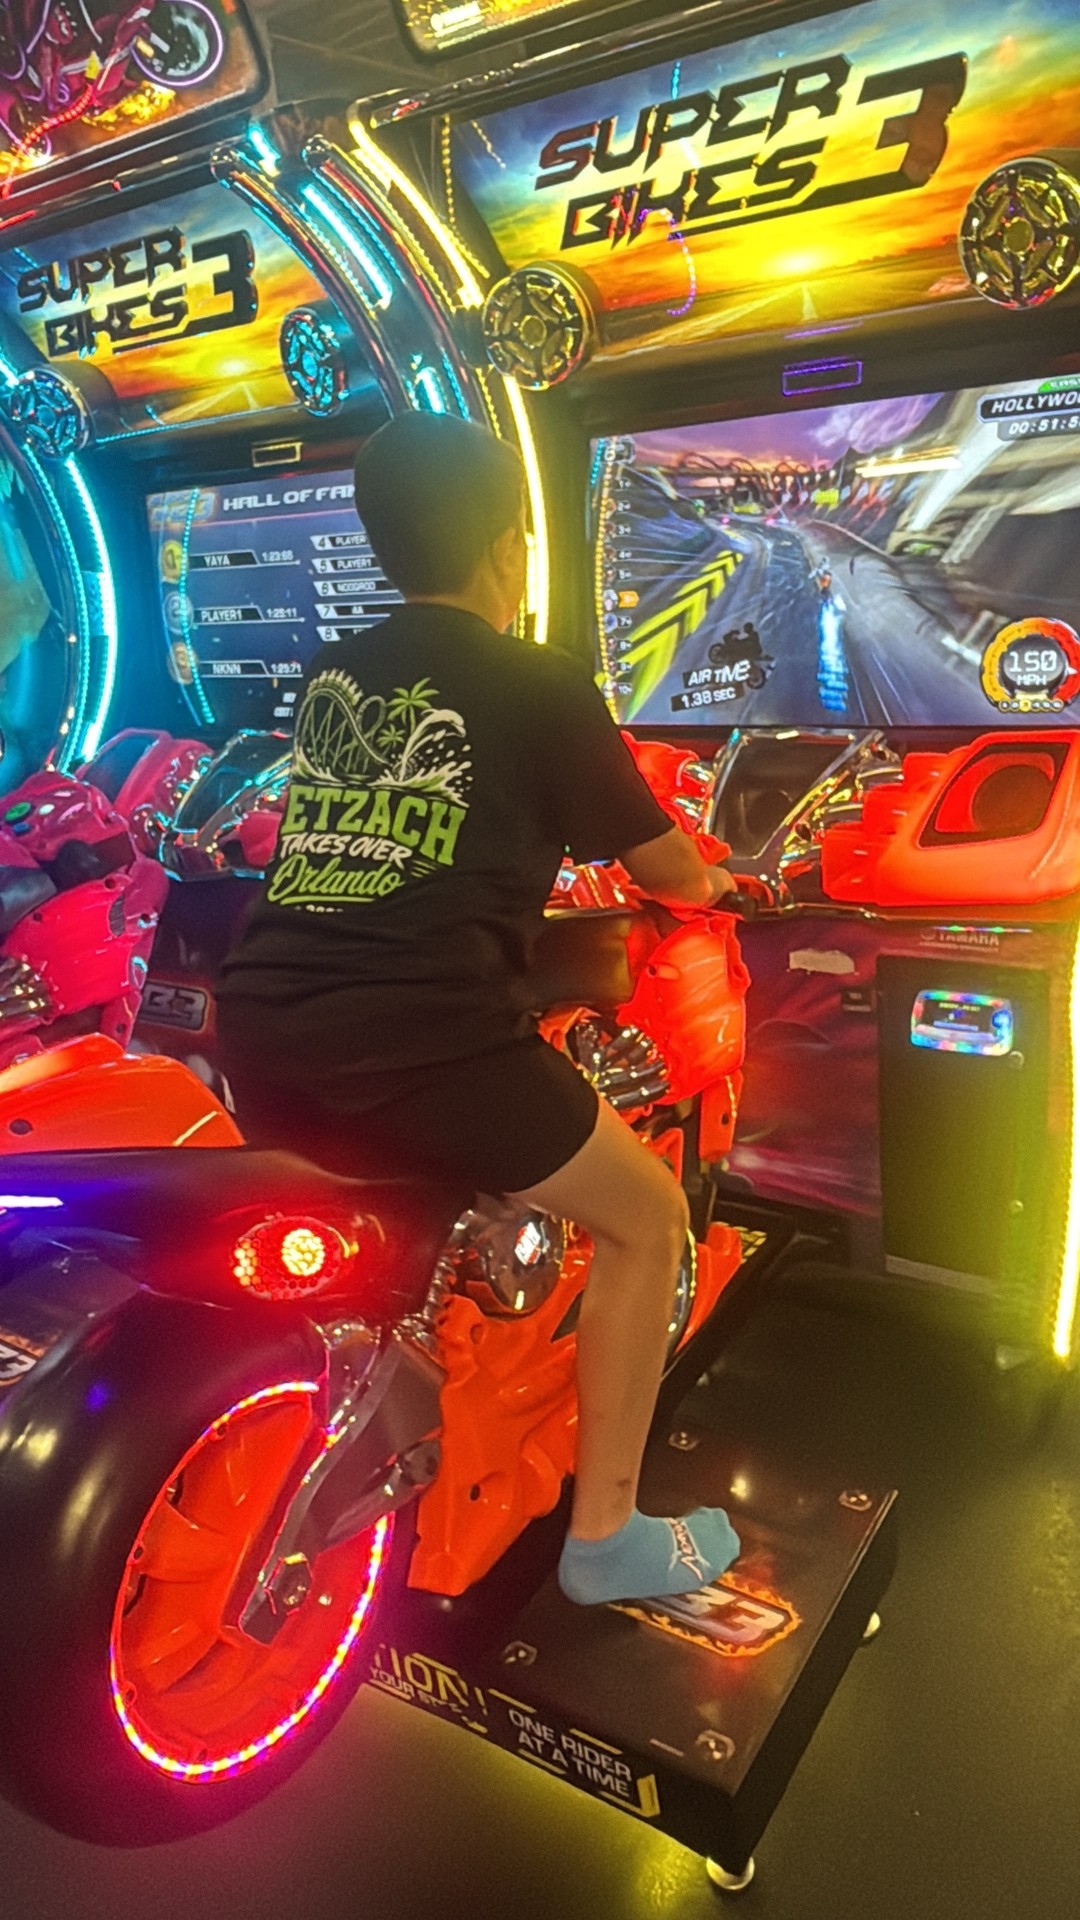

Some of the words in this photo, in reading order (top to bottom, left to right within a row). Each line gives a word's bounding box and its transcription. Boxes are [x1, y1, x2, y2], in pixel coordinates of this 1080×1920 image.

[534, 53, 854, 190] SUPER
[856, 50, 969, 194] 3
[560, 137, 829, 250] BIKES
[17, 226, 188, 313] SUPER
[191, 229, 259, 328] 3
[45, 284, 189, 357] BIKES
[991, 391, 1080, 414] HOLLYWO
[1009, 415, 1080, 436] 00:51:5
[223, 493, 281, 511] HALL
[282, 489, 314, 505] OF
[335, 535, 367, 546] PLAYER
[204, 554, 231, 567] YAYA
[201, 609, 242, 621] PLAYER1
[322, 605, 331, 617] 7
[688, 668, 712, 687] AIR
[713, 659, 751, 683] TIME
[1009, 650, 1058, 673] 150
[713, 687, 736, 703] SEC
[1016, 673, 1047, 686] MPH
[281, 784, 466, 866] ETZACH
[280, 832, 352, 860] TAKES
[348, 836, 413, 870] OVER
[267, 853, 406, 902] Orlando
[369, 1666, 416, 1698] YOUR
[509, 1709, 555, 1744] ONE
[561, 1735, 632, 1781] RIDER
[518, 1731, 545, 1752] AT
[552, 1750, 569, 1767] A
[571, 1757, 630, 1797] TIME
